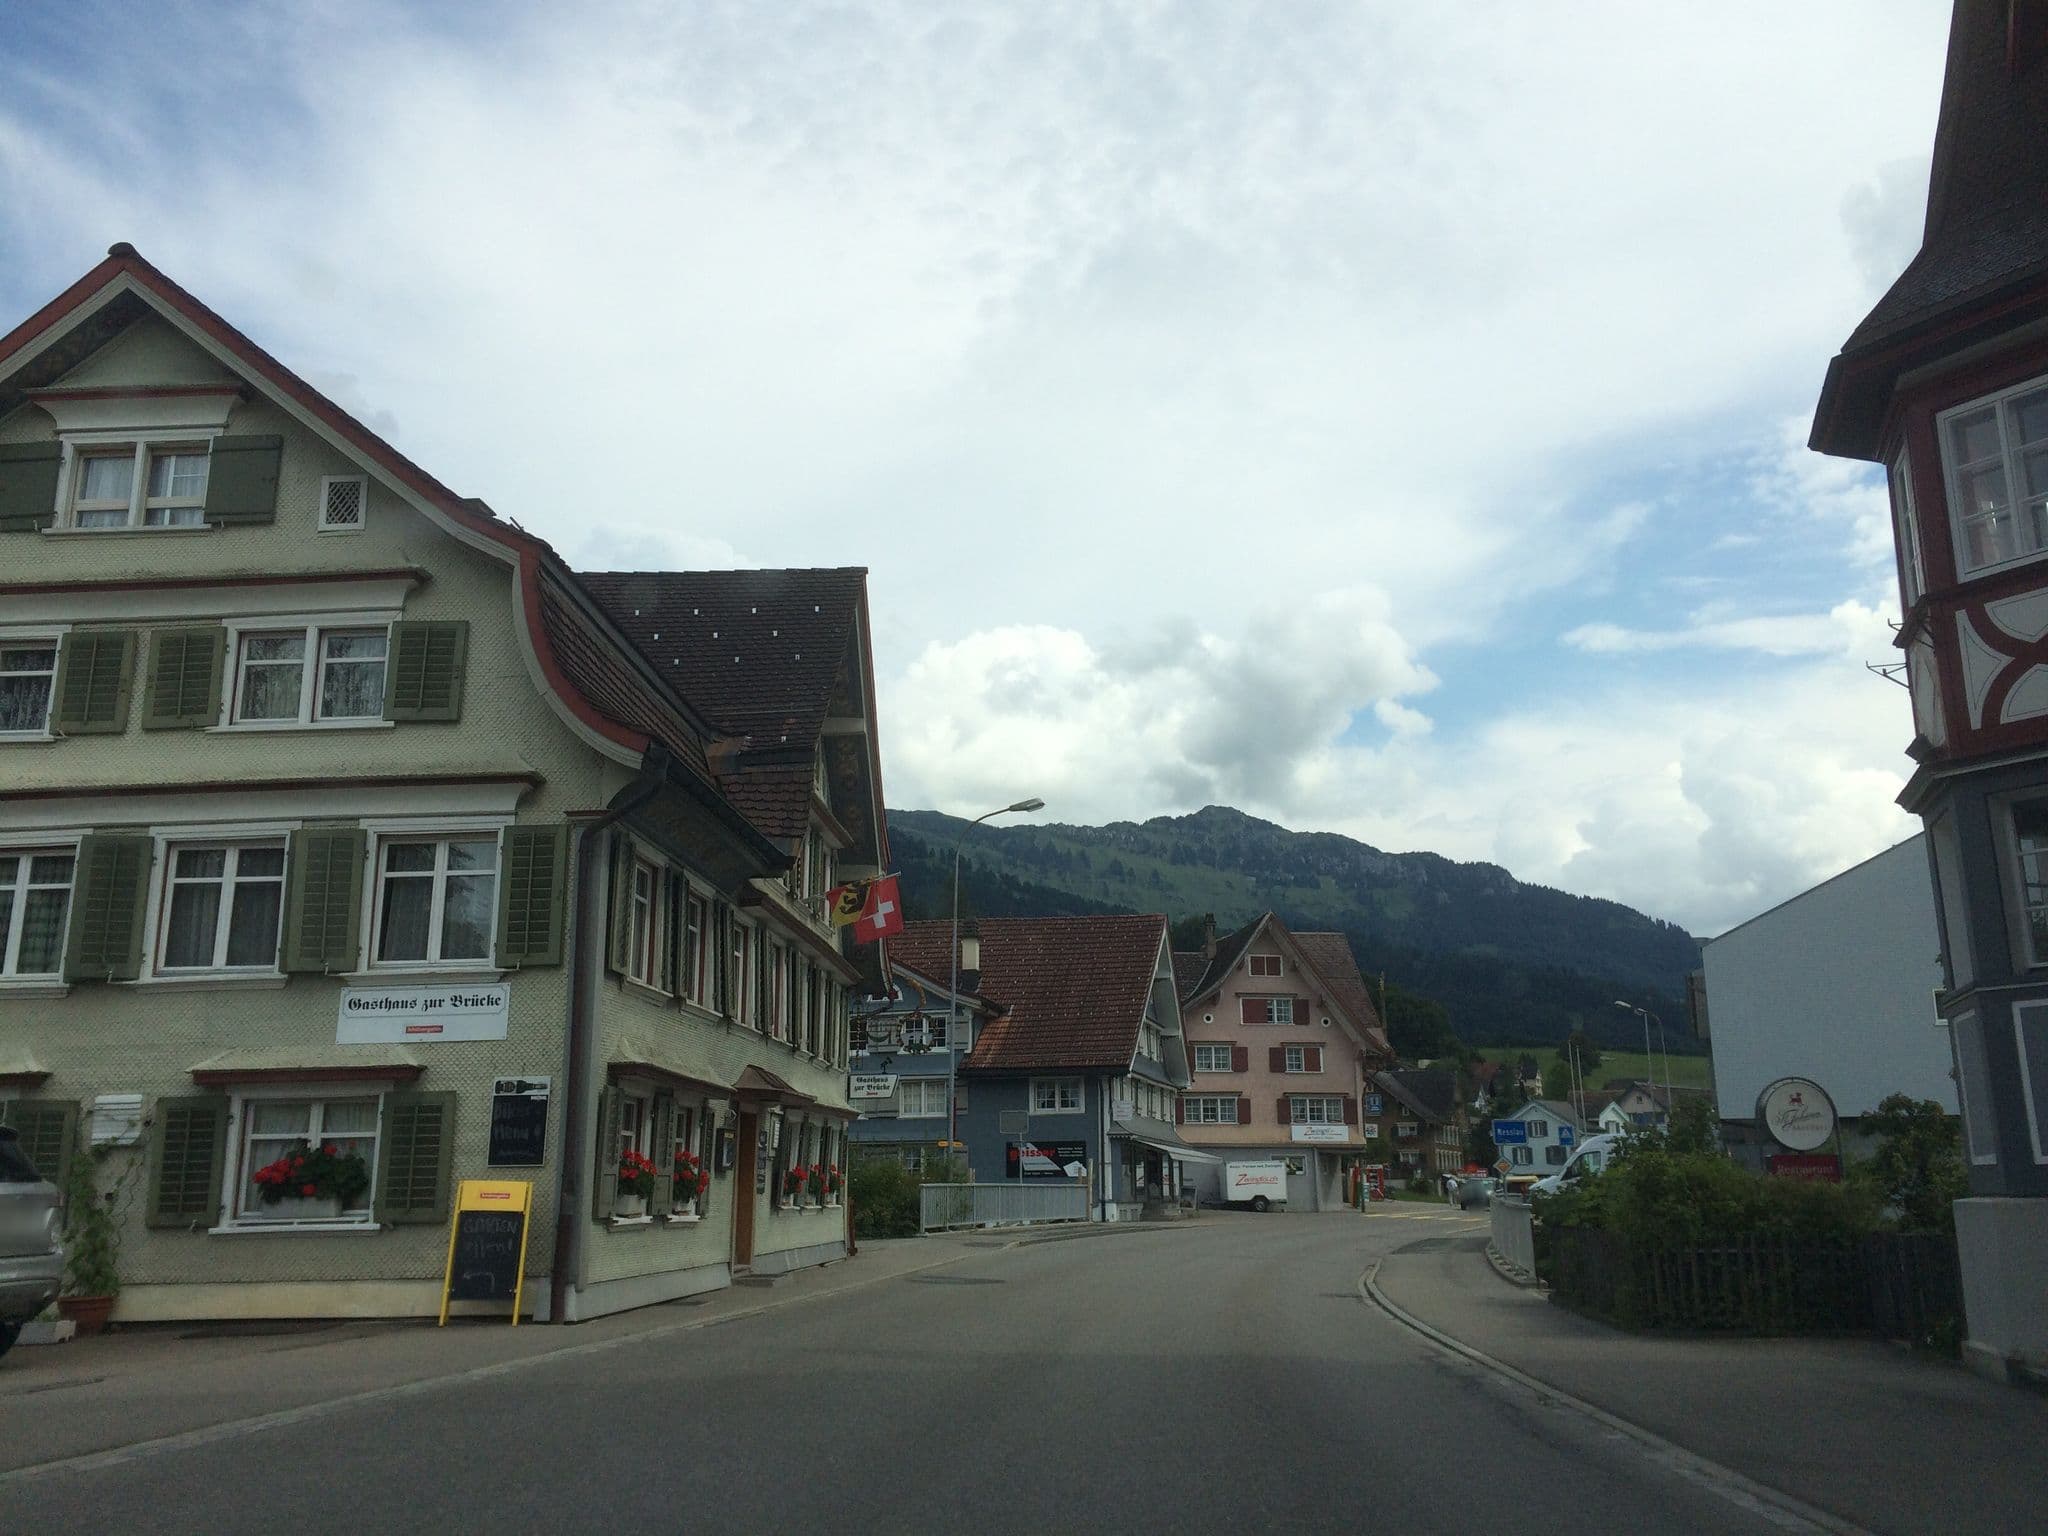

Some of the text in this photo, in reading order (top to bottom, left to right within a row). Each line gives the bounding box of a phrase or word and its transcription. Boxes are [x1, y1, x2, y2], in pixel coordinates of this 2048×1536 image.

[348, 994, 502, 1012] Gasthaus zur Brücke
[856, 1076, 889, 1084] Gasthaus
[867, 1083, 891, 1091] Brücke
[1497, 1128, 1524, 1136] Nesslau
